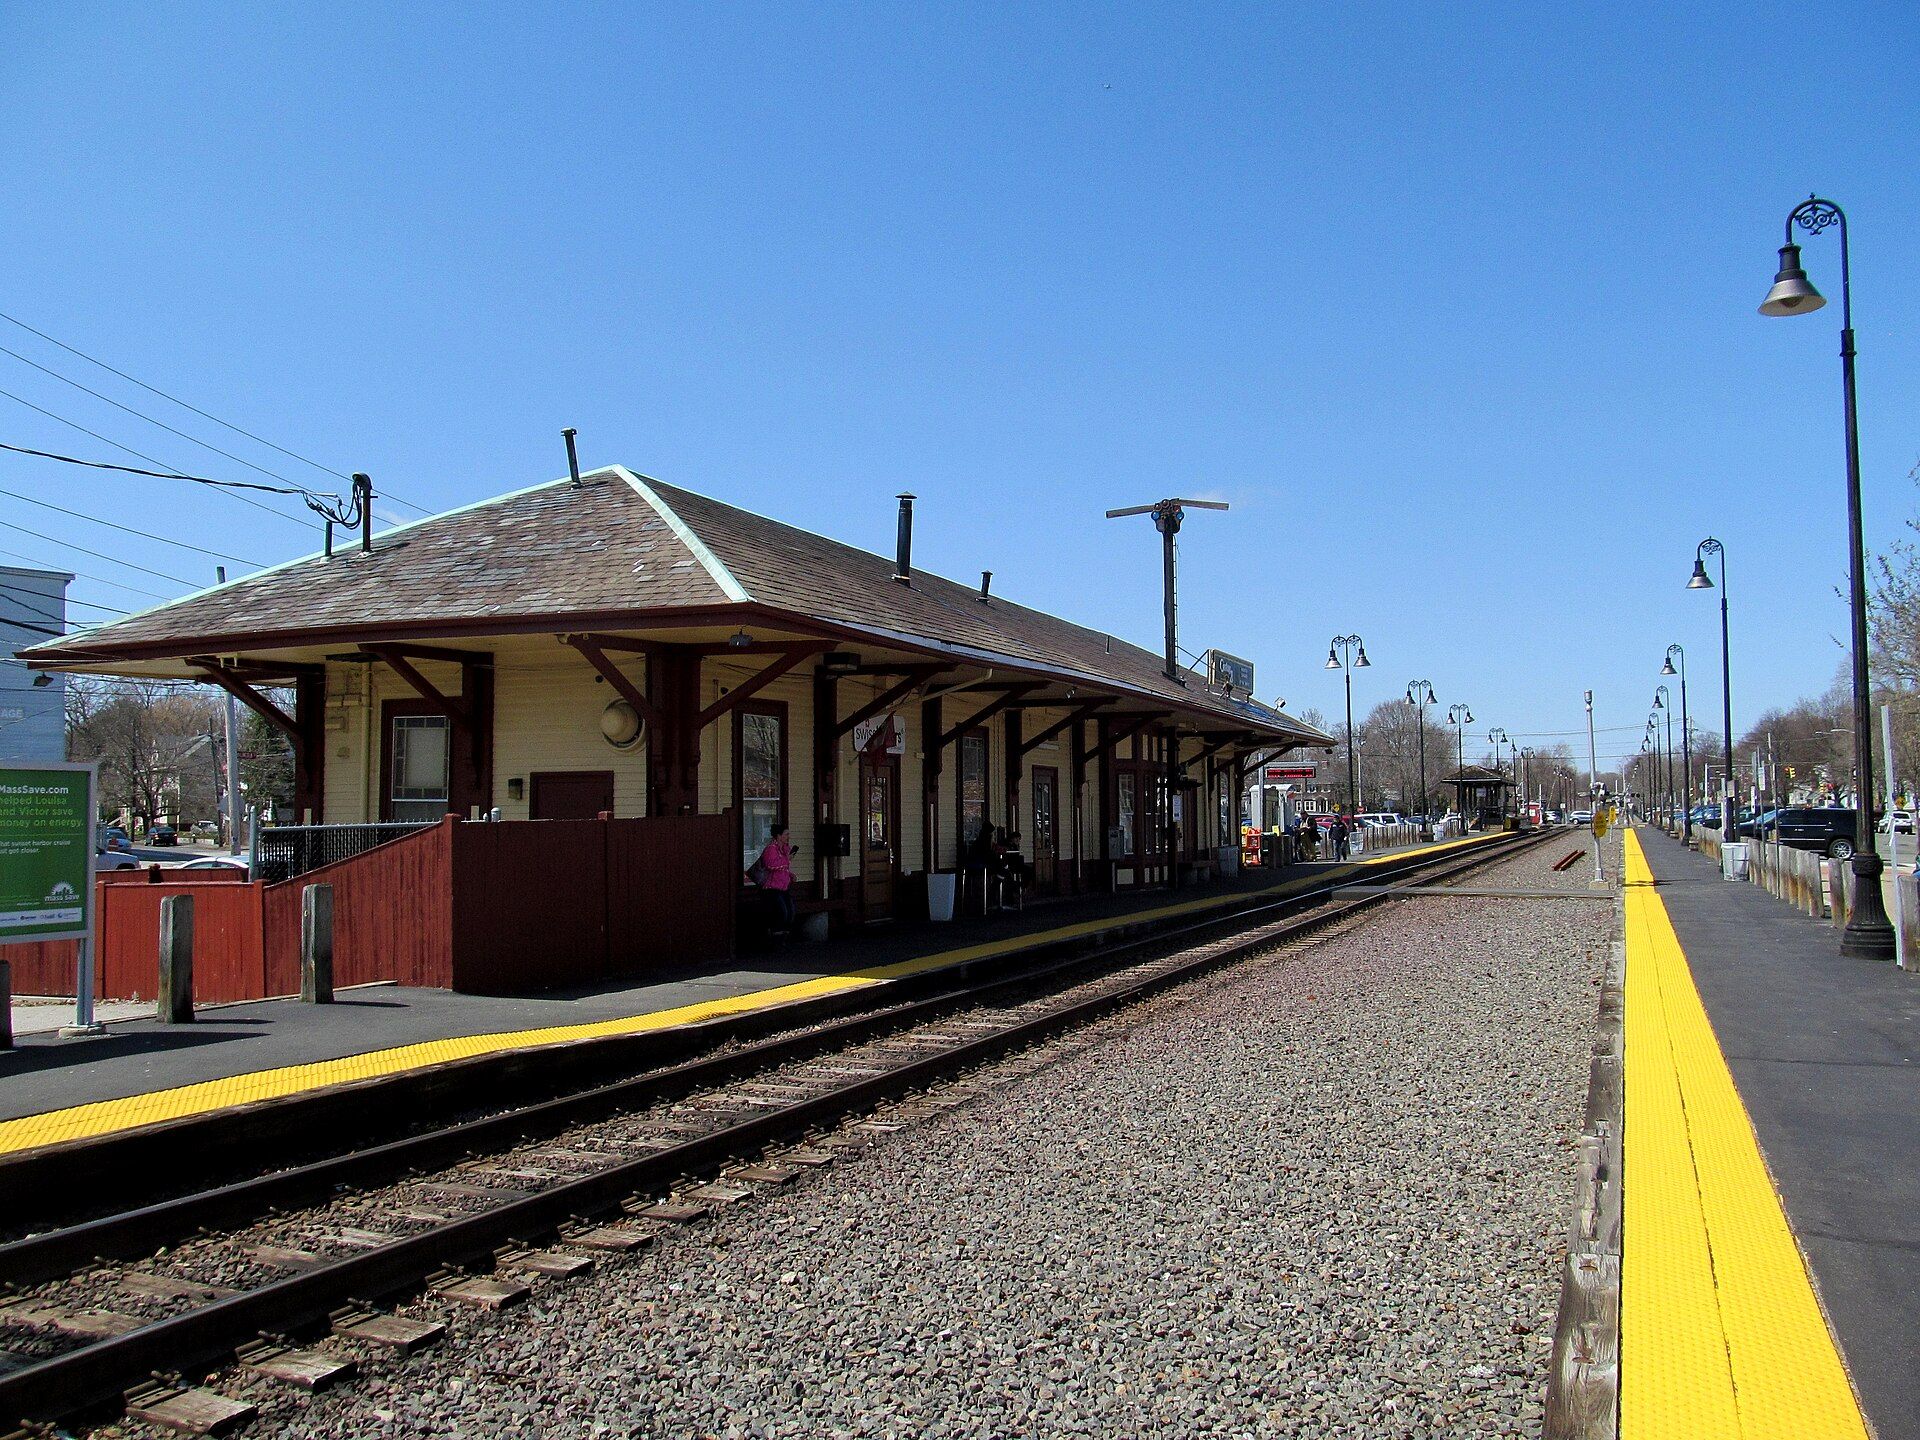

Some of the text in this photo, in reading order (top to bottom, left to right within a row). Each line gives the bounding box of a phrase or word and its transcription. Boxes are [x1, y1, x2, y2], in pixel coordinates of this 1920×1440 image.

[0, 785, 69, 794] MassSave.com
[35, 796, 67, 805] Louisa
[19, 807, 49, 816] Victor
[52, 808, 74, 816] save
[33, 819, 46, 827] on
[49, 819, 84, 828] energy.
